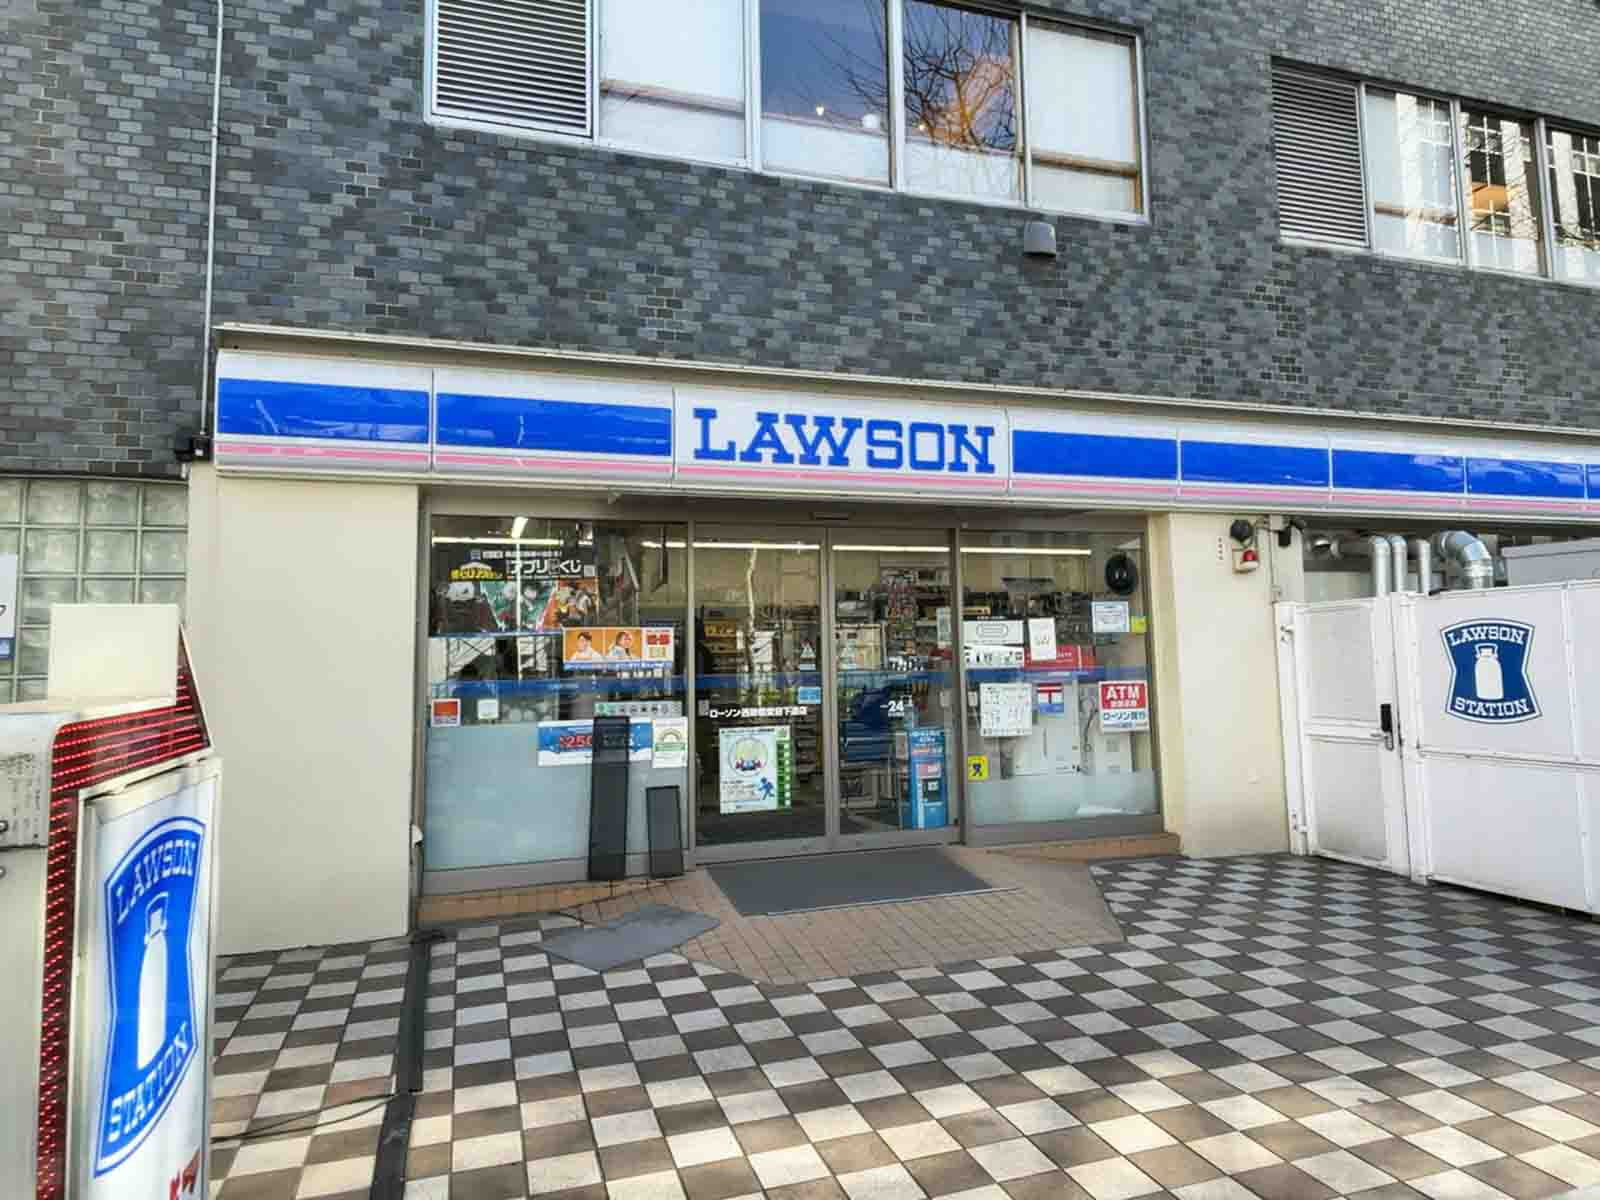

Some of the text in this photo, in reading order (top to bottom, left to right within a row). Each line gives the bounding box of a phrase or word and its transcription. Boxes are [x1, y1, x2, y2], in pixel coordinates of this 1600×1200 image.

[692, 407, 996, 475] LAWSON
[1447, 624, 1526, 646] LAWSON
[1106, 686, 1141, 700] ATM
[1454, 697, 1529, 718] STATION
[116, 839, 197, 924] LAWSON
[107, 1020, 190, 1144] STATION
